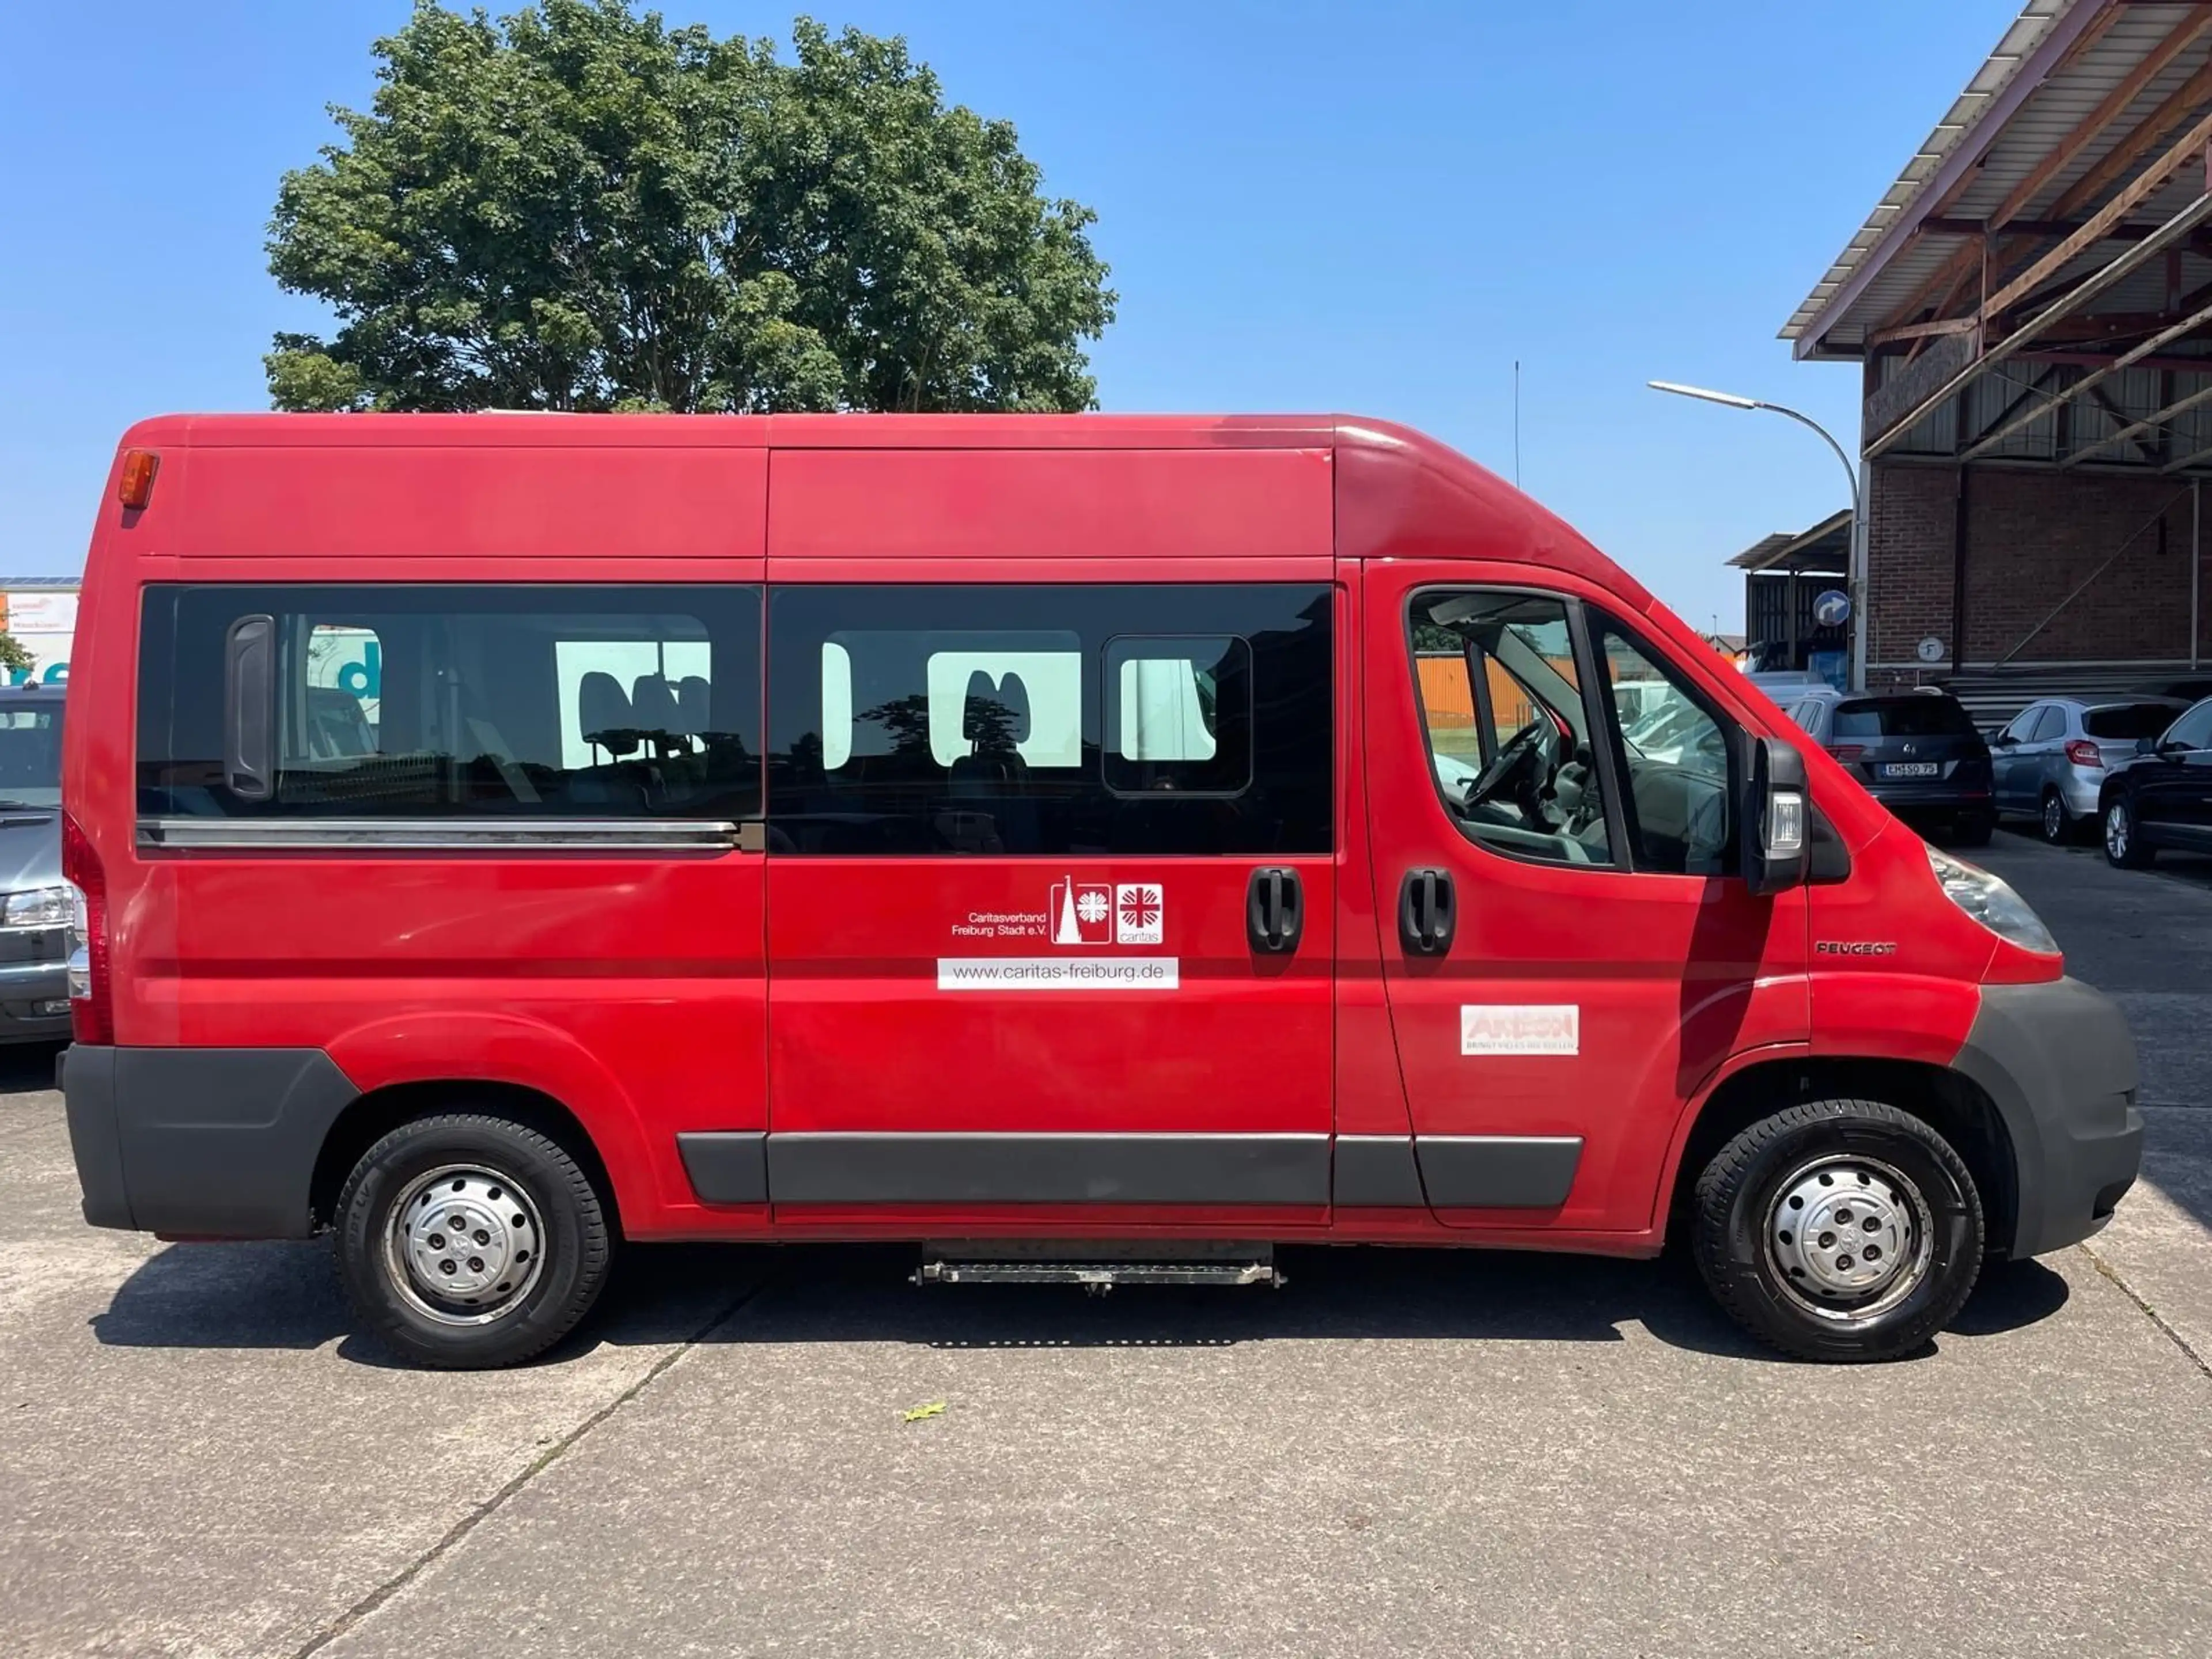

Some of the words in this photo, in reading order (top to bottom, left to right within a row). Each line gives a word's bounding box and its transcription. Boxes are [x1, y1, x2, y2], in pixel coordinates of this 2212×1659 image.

[969, 912, 1047, 923] Caritasverband
[952, 925, 994, 938] Freiburg
[998, 925, 1026, 935] Stadt
[1028, 925, 1047, 935] e.V.
[1120, 931, 1158, 942] caritas
[1817, 941, 1897, 955] PEUGEOT
[953, 964, 1164, 982] www.caritas-freiburg.de
